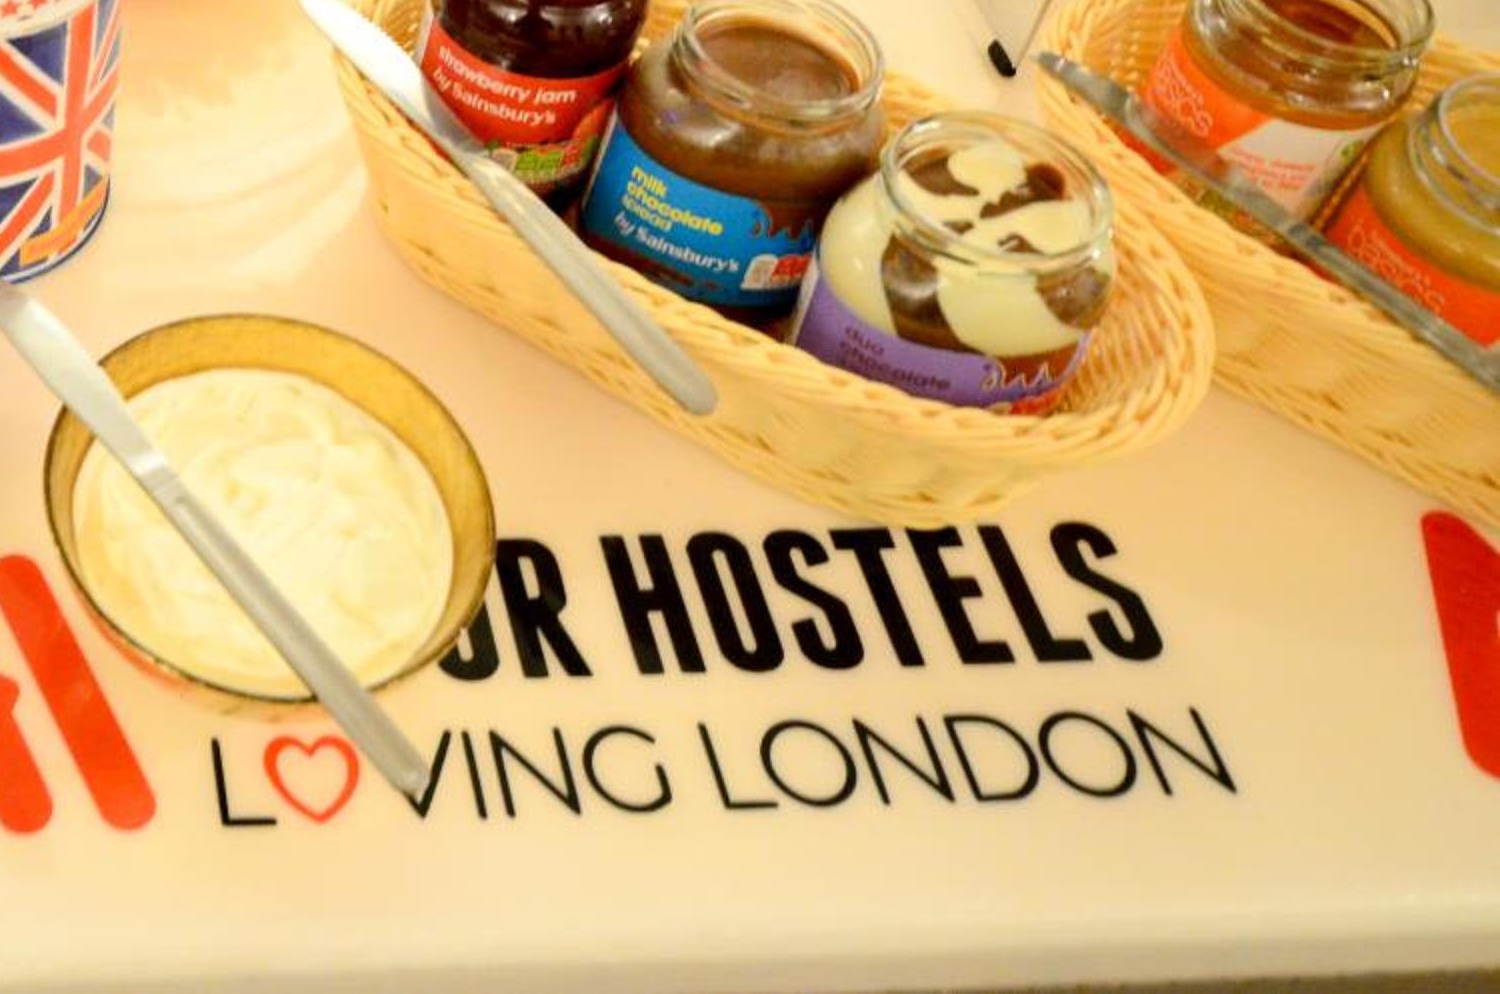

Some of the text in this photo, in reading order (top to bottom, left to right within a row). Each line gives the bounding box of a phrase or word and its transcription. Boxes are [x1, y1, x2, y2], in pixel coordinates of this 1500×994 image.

[432, 67, 557, 126] by Sainsbury's
[439, 46, 577, 106] strawberry jam
[627, 181, 724, 236] chocolate
[631, 165, 668, 197] milk
[614, 212, 740, 273] by Sainsbury's
[839, 339, 952, 391] chocolate
[845, 325, 885, 356] duo
[599, 521, 1164, 675] HOSTELS
[697, 708, 1238, 811] LONDON
